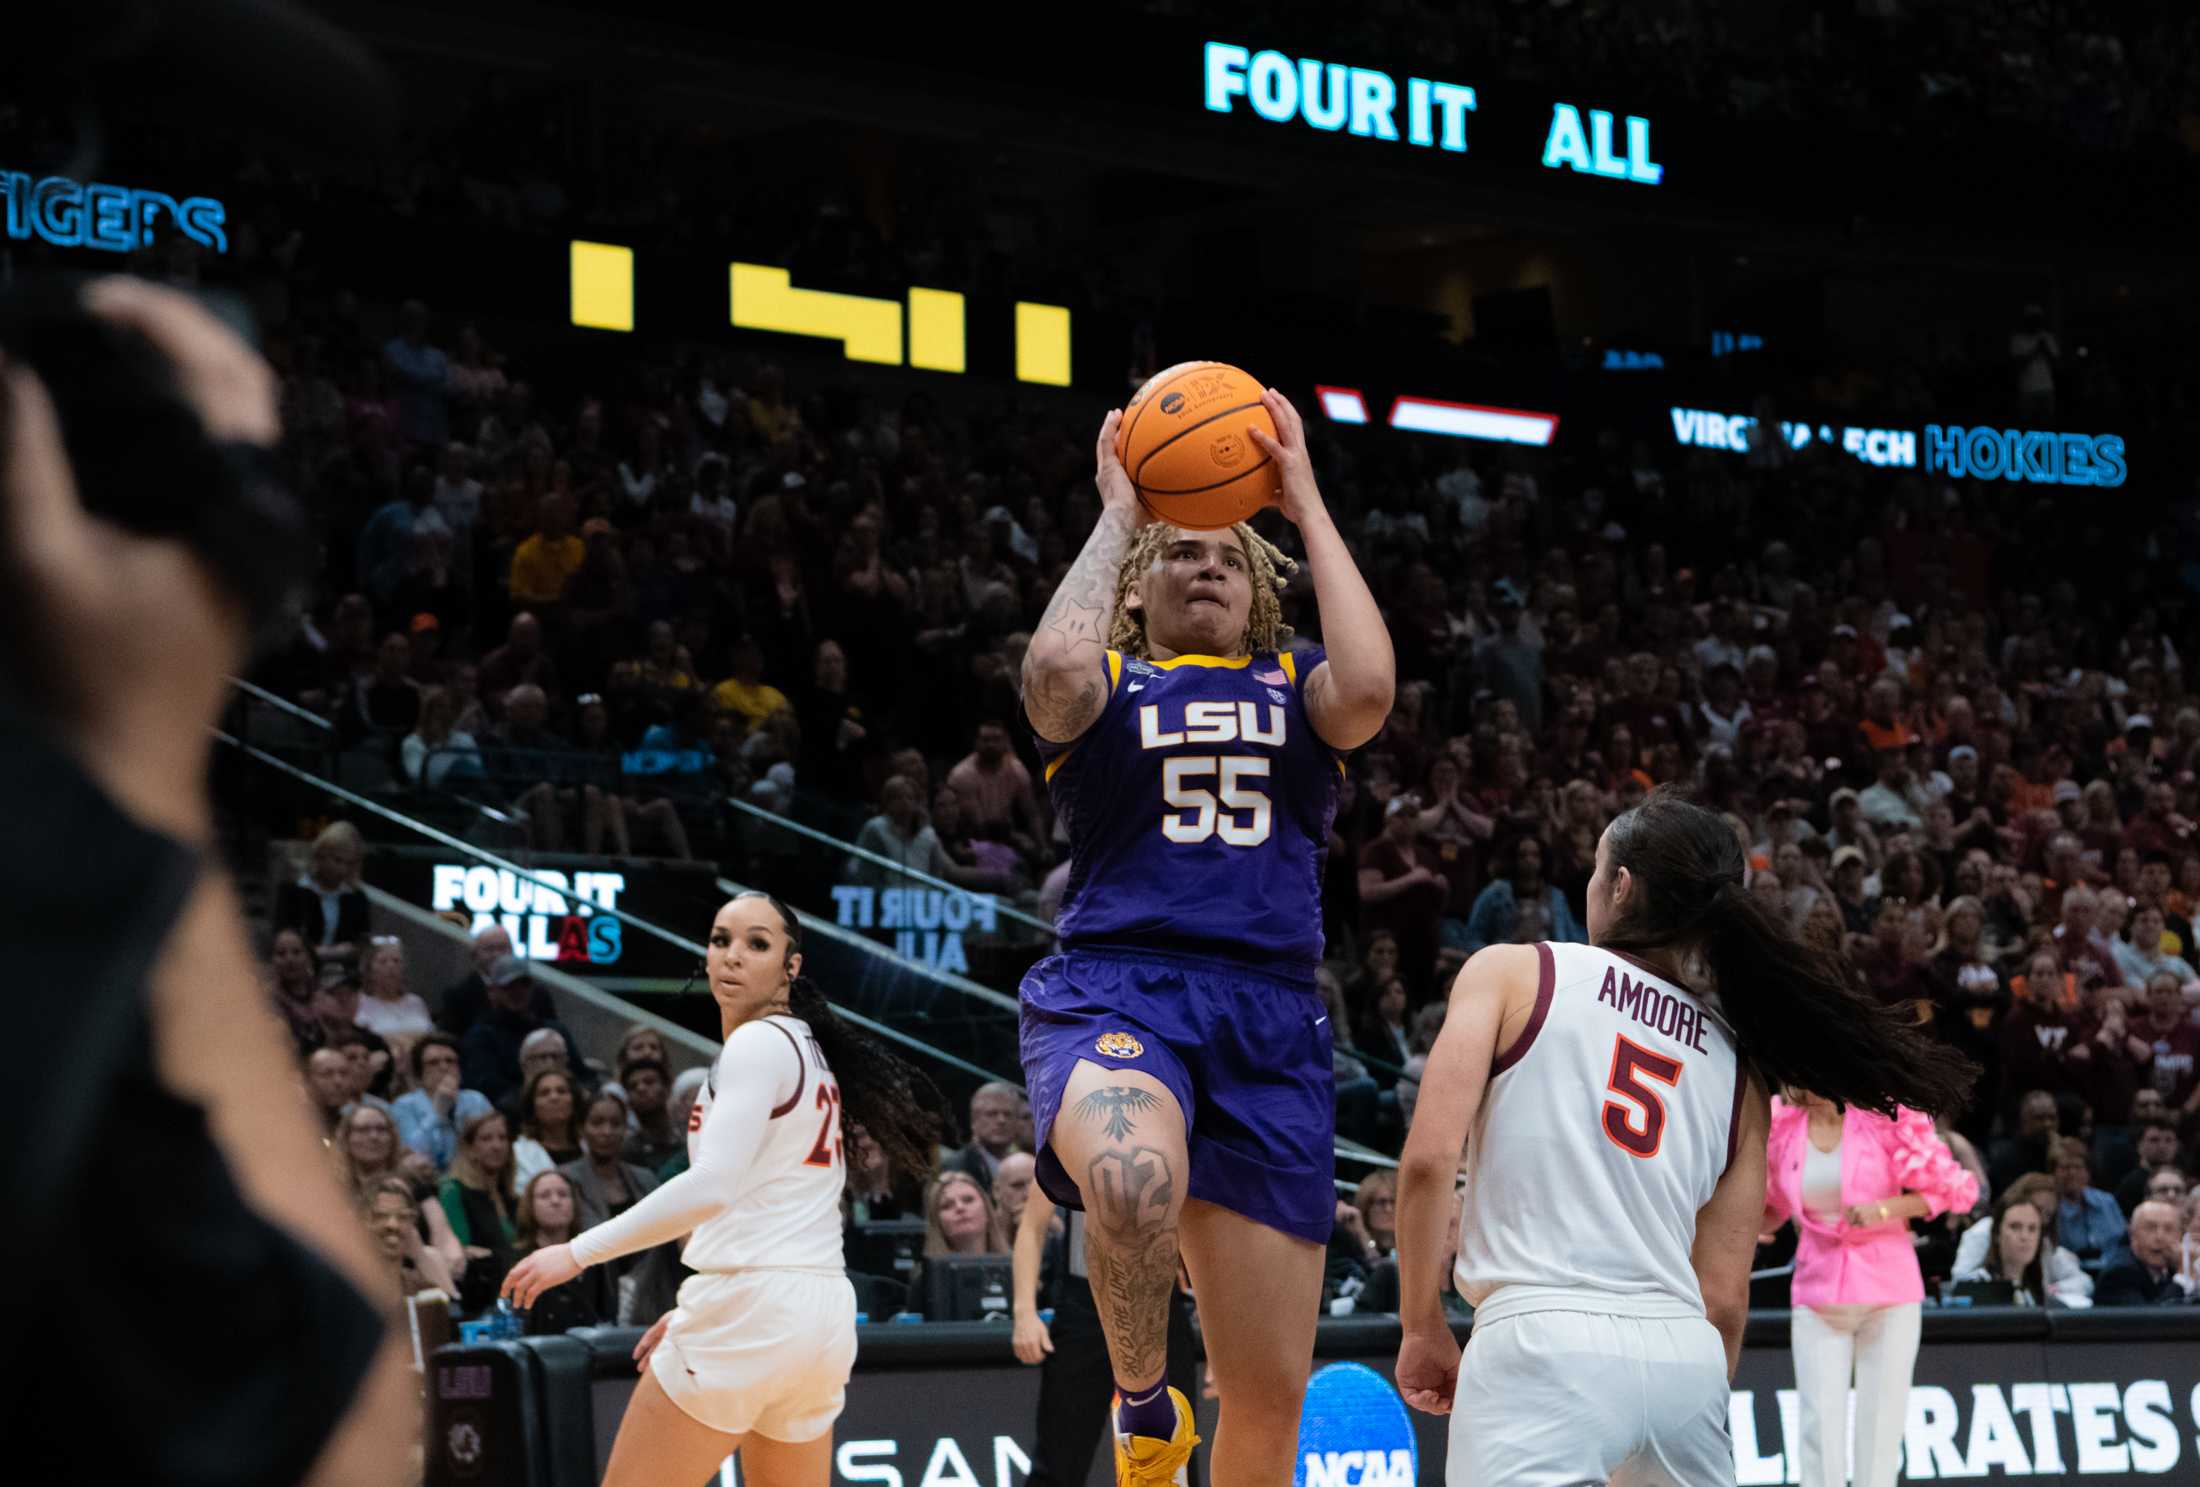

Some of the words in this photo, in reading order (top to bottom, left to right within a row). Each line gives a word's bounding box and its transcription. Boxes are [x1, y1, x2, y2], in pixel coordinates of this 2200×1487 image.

[1204, 41, 1399, 141] FOUR
[1408, 76, 1477, 152] IT
[1542, 103, 1664, 185] ALL
[1924, 423, 2127, 487] HOKIES
[1139, 701, 1286, 749] LSU
[1162, 755, 1272, 846] 55
[432, 864, 569, 916] FOUR
[1599, 965, 1711, 1056] AMOORE
[1601, 1032, 1684, 1158] 5
